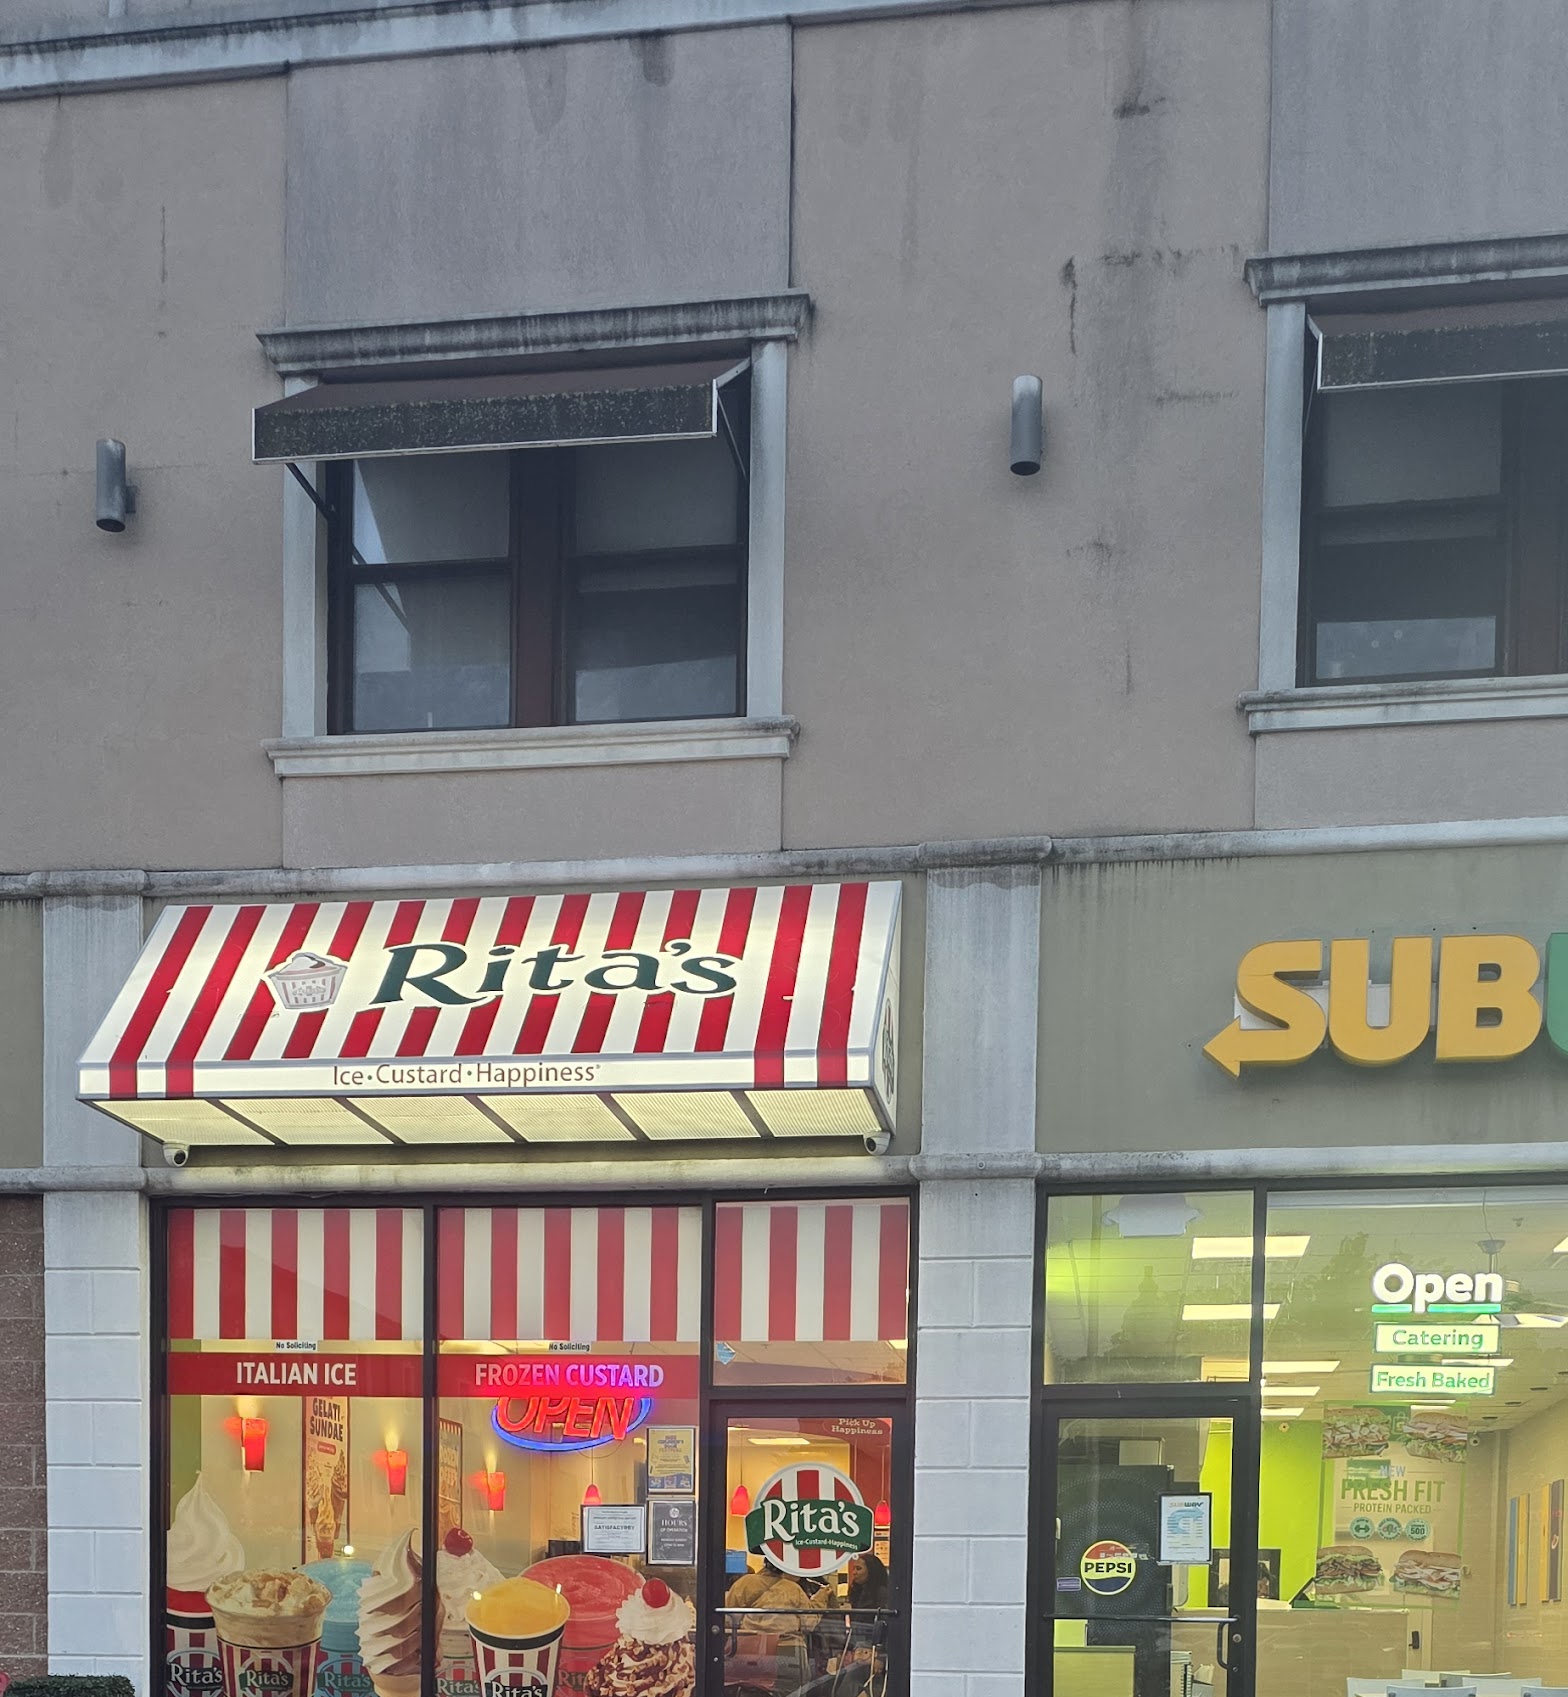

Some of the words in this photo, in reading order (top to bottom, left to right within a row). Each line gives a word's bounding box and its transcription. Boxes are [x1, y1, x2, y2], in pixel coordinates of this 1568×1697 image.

[369, 941, 736, 1006] Rita's
[1202, 932, 1568, 1079] SUB
[1372, 1263, 1503, 1312] Open
[276, 1341, 285, 1349] No
[286, 1341, 317, 1351] Soliciting
[549, 1342, 558, 1350] No
[559, 1342, 590, 1352] Soliciting
[1392, 1328, 1484, 1351] Catering
[236, 1362, 318, 1386] ITALIAN
[324, 1362, 357, 1386] ICE
[475, 1363, 560, 1387] FROZEN
[565, 1364, 664, 1388] CUSTARD
[1376, 1371, 1426, 1388] Fresh
[1431, 1371, 1490, 1389] Baked
[312, 1397, 341, 1422] GELATI
[497, 1396, 635, 1440] OPEN
[309, 1416, 344, 1442] SUNDAE
[831, 1424, 883, 1434] Happiness
[862, 1420, 876, 1428] Up
[1380, 1465, 1406, 1477] NEW
[1341, 1478, 1408, 1501] FRESH
[1414, 1480, 1446, 1502] FIT
[1353, 1502, 1392, 1513] PROTEIN
[1395, 1504, 1431, 1514] PACKED
[661, 1519, 687, 1527] HOURS
[763, 1499, 860, 1541] Rita's
[1084, 1562, 1132, 1573] PEPSI
[170, 1663, 223, 1686] Rita's
[246, 1669, 289, 1687] Rita's
[325, 1671, 371, 1688] Rita's
